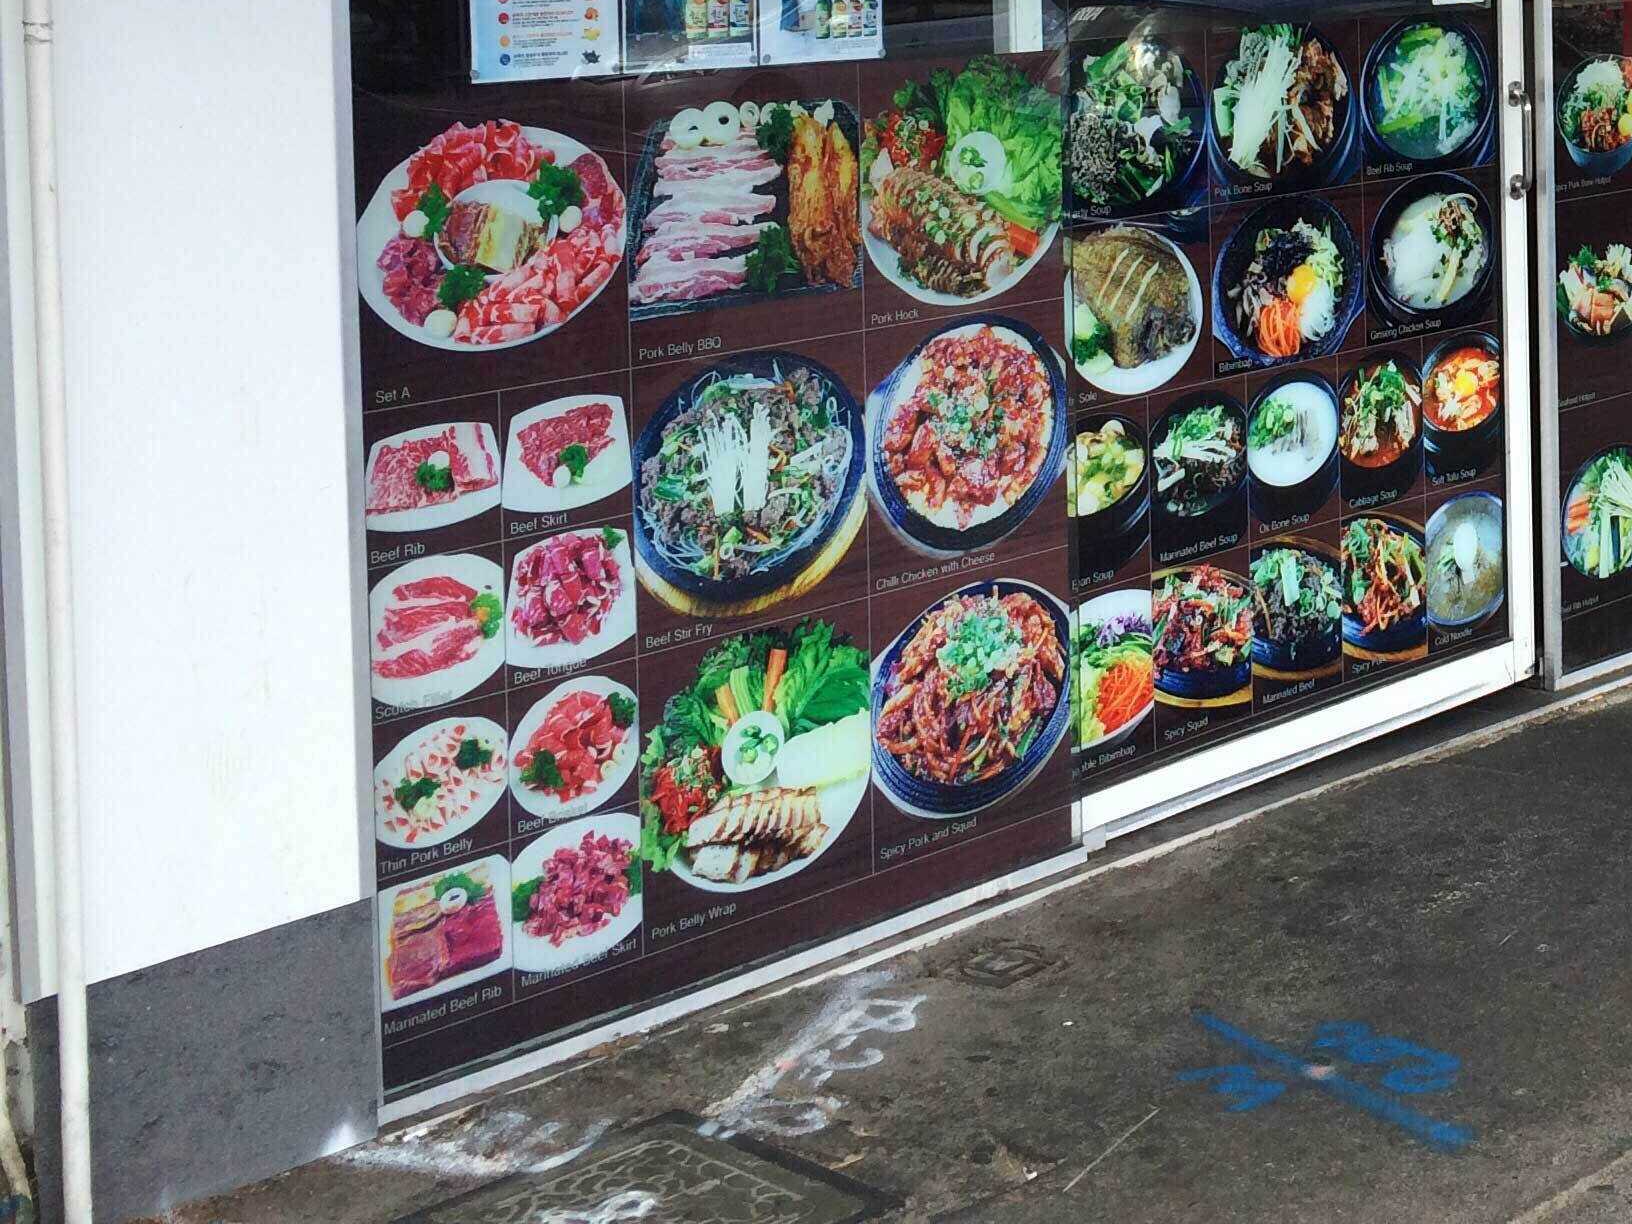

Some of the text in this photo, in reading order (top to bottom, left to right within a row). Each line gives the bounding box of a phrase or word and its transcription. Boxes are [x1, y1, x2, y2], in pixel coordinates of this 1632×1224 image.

[1233, 183, 1253, 195] Bone
[1253, 181, 1273, 193] Soup
[1090, 204, 1112, 217] Soup
[871, 307, 920, 326] Pork Hock
[1425, 318, 1442, 330] Soup
[639, 335, 722, 361] Pork Belly BBQ
[375, 387, 411, 405] Set A
[1460, 467, 1477, 479] Soup
[1380, 488, 1398, 501] Soup
[509, 511, 568, 535] Beef Skirt
[1271, 517, 1291, 531] Bone
[1291, 512, 1310, 525] Soup
[1218, 533, 1238, 547] Soup
[370, 541, 425, 566] Beef Rib
[901, 566, 938, 584] Chicken
[940, 559, 959, 574] with
[961, 551, 996, 570] Cheese
[1093, 569, 1114, 584] Soup
[645, 621, 713, 650] Beef Stir Fry
[513, 666, 541, 685] Beef
[1298, 677, 1316, 694] Beef
[1163, 715, 1209, 742] Spicy Squid
[517, 816, 545, 834] Beef
[879, 815, 977, 862] Spicy Pork and Squid
[379, 837, 474, 876] Thin Pork Belly
[651, 901, 737, 941] Pork Belly Wrap
[582, 946, 609, 965] Beef
[611, 937, 639, 956] Skirt
[383, 984, 503, 1036] Marinated Beef Rib
